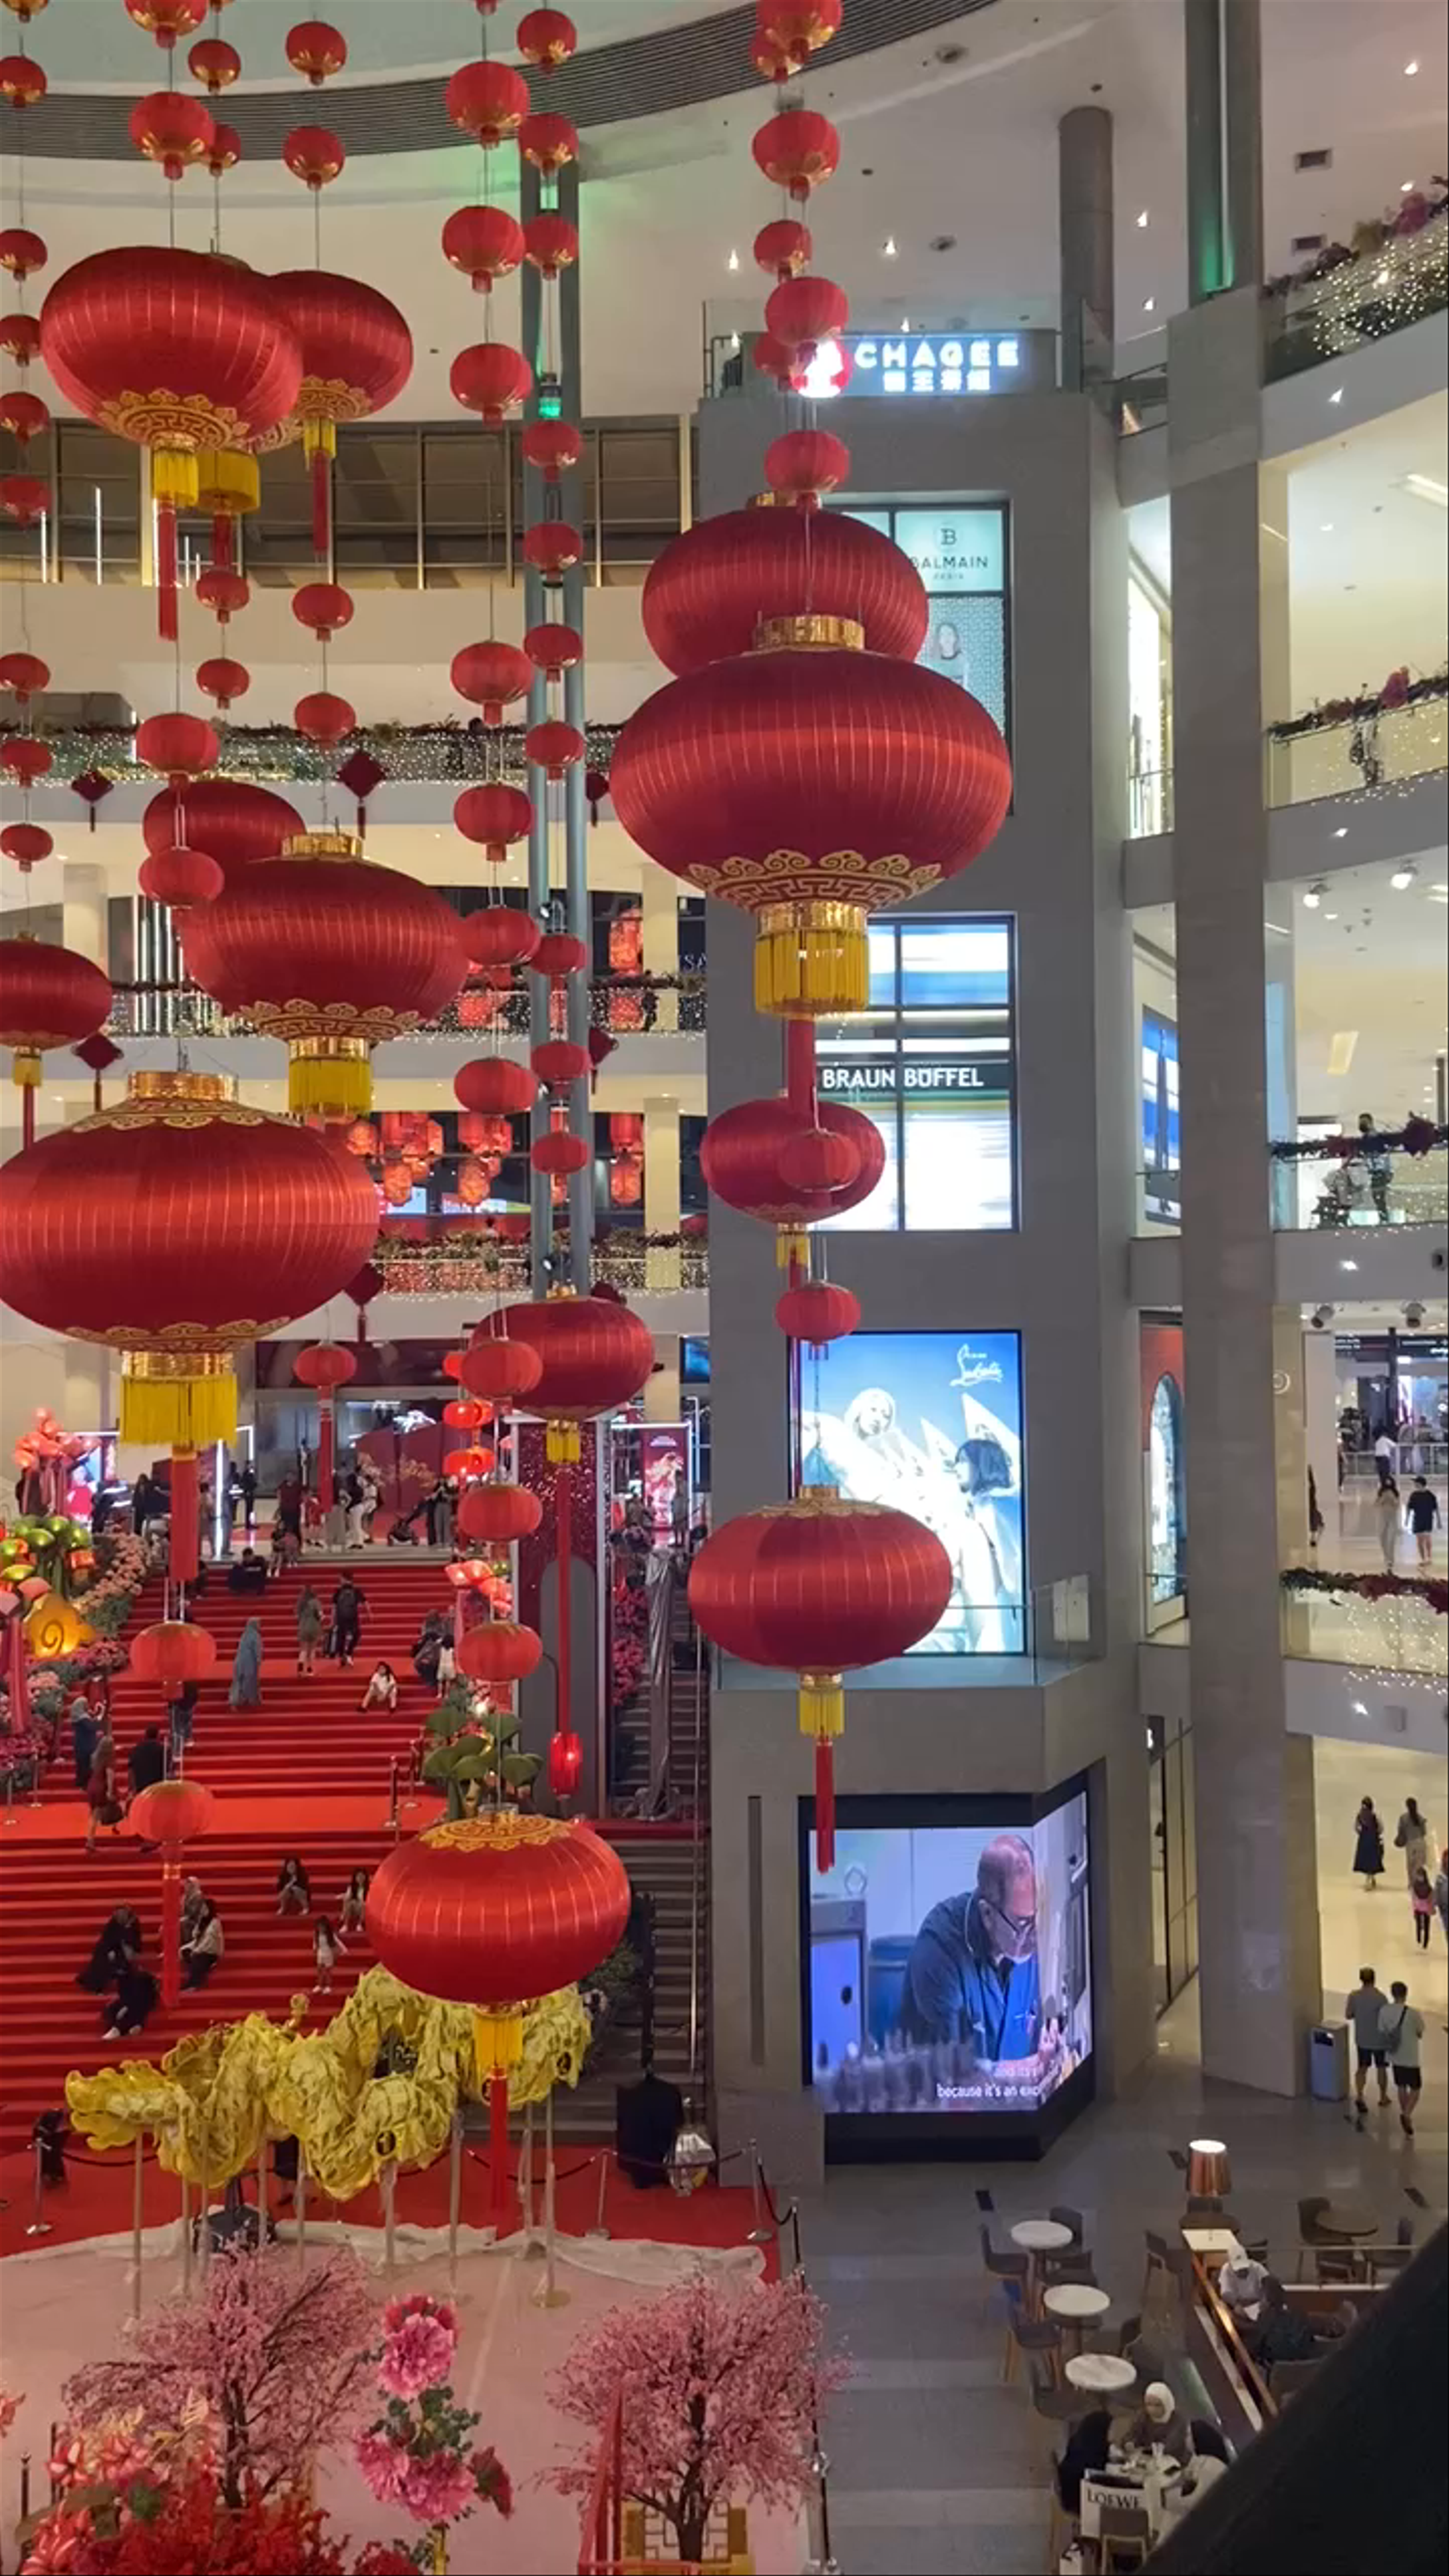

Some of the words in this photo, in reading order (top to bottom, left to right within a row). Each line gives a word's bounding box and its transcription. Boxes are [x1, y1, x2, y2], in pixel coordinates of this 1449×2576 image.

[855, 341, 1018, 368] CHAGEE
[823, 1069, 895, 1089] BRAUN
[904, 1067, 984, 1087] BÜFFEL
[937, 2083, 982, 2098] because
[1003, 2086, 1018, 2097] an
[1087, 2487, 1139, 2509] LOEWE
